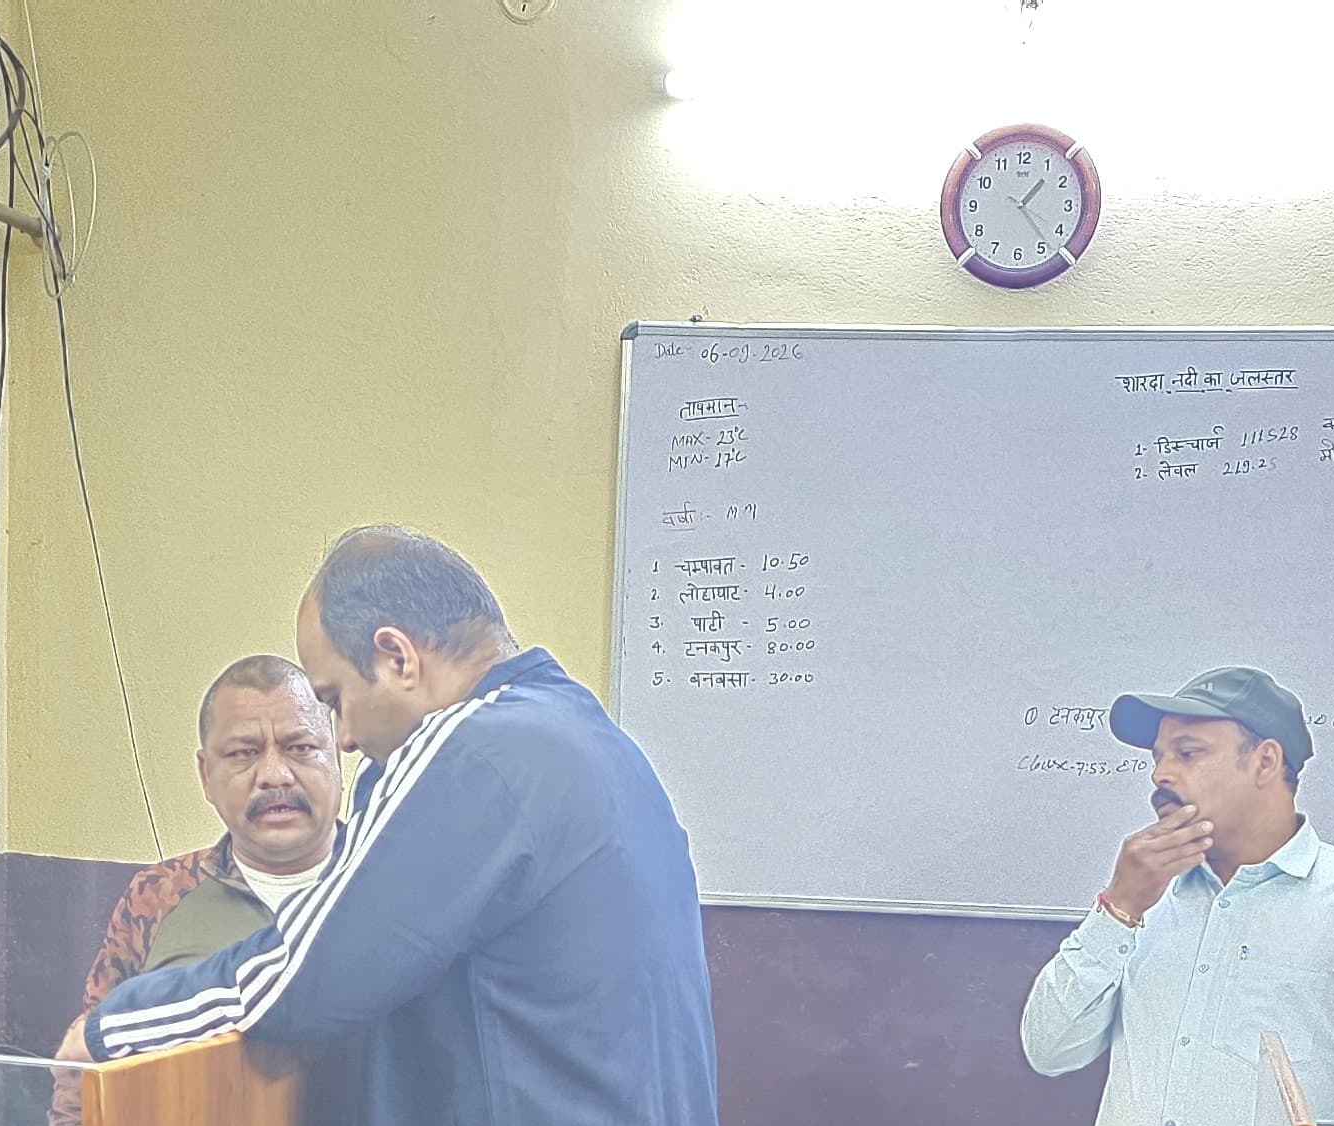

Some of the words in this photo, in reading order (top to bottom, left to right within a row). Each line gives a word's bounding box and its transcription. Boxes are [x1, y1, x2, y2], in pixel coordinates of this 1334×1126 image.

[995, 158, 1007, 171] 11
[1017, 152, 1031, 165] 12
[1044, 158, 1050, 171] 1
[977, 176, 992, 190] 10
[1058, 175, 1067, 189] 2
[969, 200, 978, 213] 9
[1064, 200, 1073, 213] 3
[974, 224, 984, 237] 8
[1054, 224, 1064, 236] 4
[991, 242, 1000, 255] 7
[1013, 248, 1022, 261] 6
[1036, 242, 1046, 255] 5
[1115, 372, 1165, 393] शारदा
[1171, 366, 1199, 387] नदी
[1203, 371, 1224, 388] का
[1230, 369, 1297, 388] जलस्तर
[1158, 459, 1199, 481] लेवल
[765, 583, 805, 601] 4.00
[690, 610, 725, 632] पाटी
[765, 617, 811, 632] 5.00
[767, 639, 815, 655] 80.00
